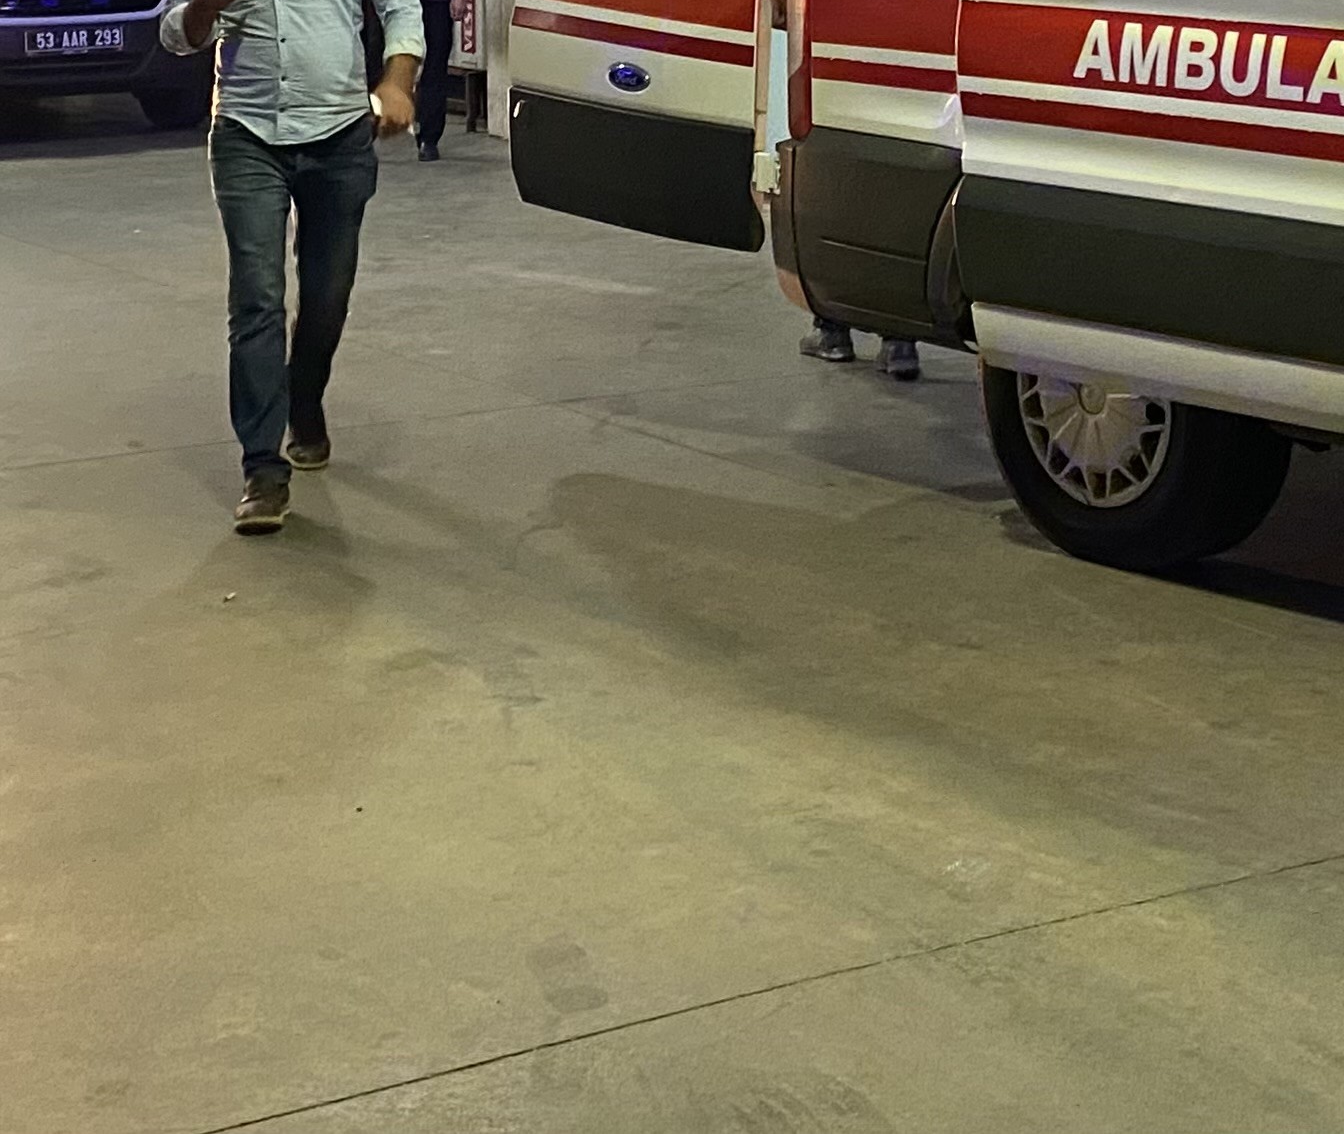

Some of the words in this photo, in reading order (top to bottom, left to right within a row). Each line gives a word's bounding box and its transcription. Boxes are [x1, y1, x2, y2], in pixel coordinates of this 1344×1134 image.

[35, 31, 56, 50] 53
[61, 30, 89, 48] AAR
[94, 28, 122, 46] 293
